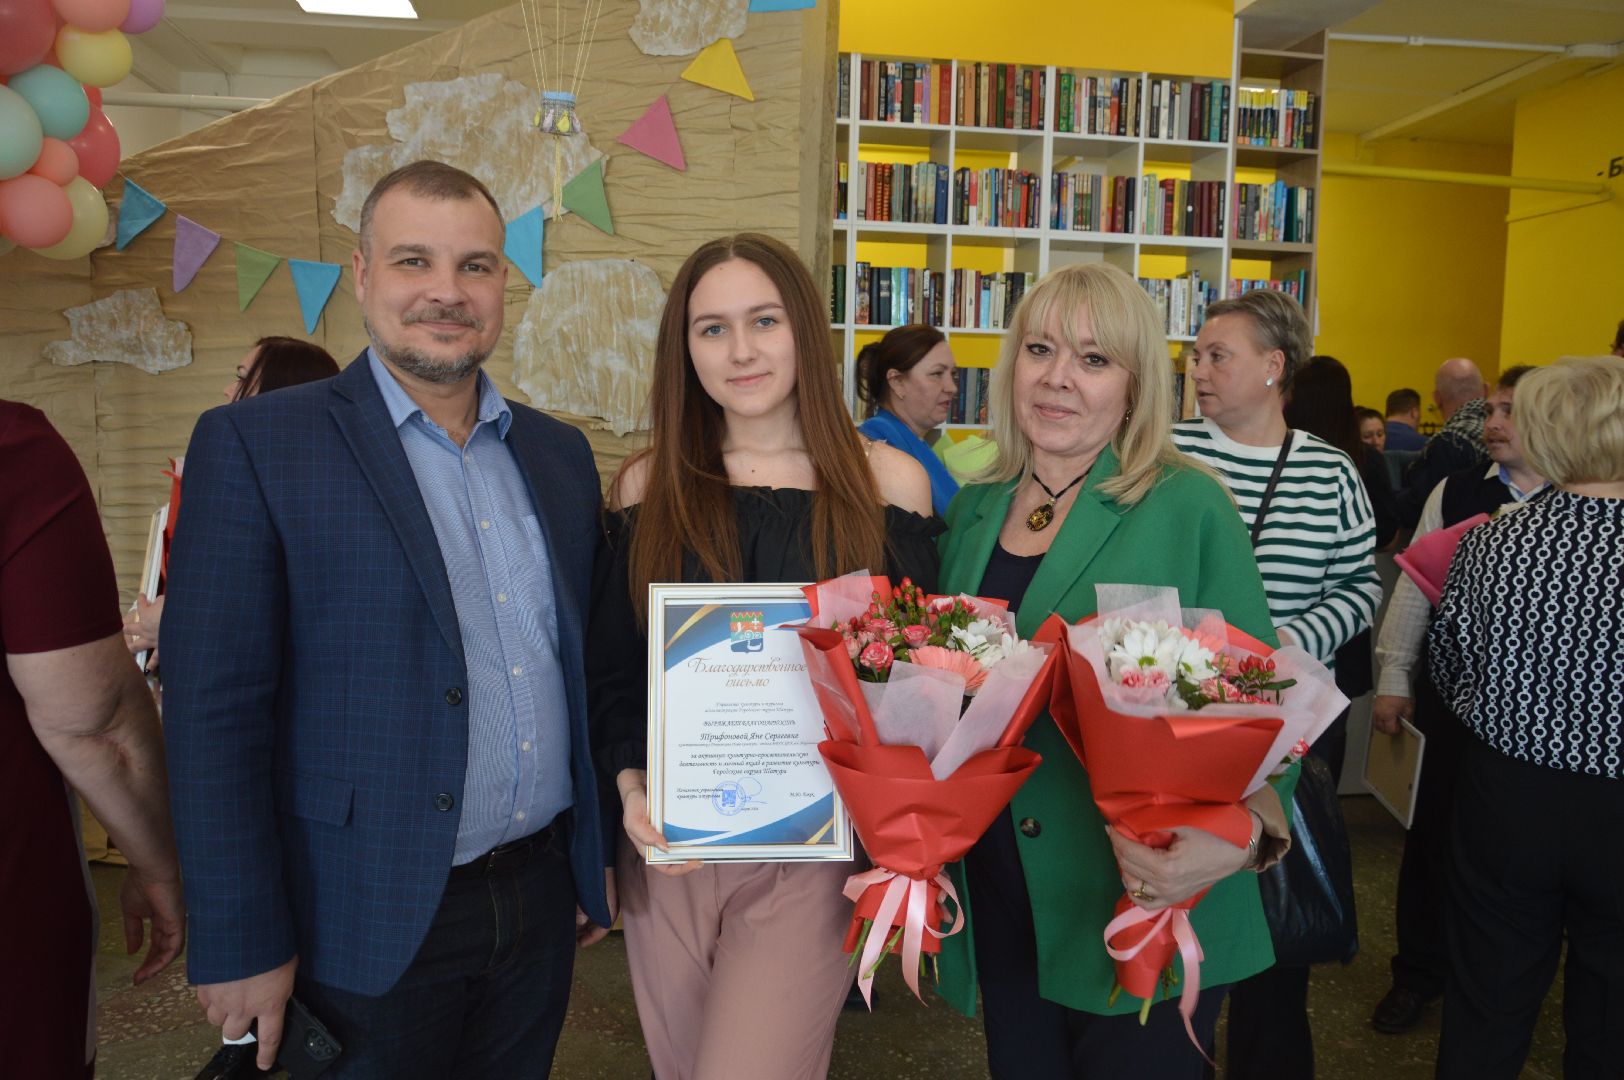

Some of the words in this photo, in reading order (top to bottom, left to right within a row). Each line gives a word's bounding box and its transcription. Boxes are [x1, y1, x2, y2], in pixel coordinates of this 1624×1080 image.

[688, 657, 807, 676] Благодарственное
[725, 676, 770, 688] письмо
[700, 732, 749, 741] Трифоновой
[764, 732, 799, 741] Сергеевне
